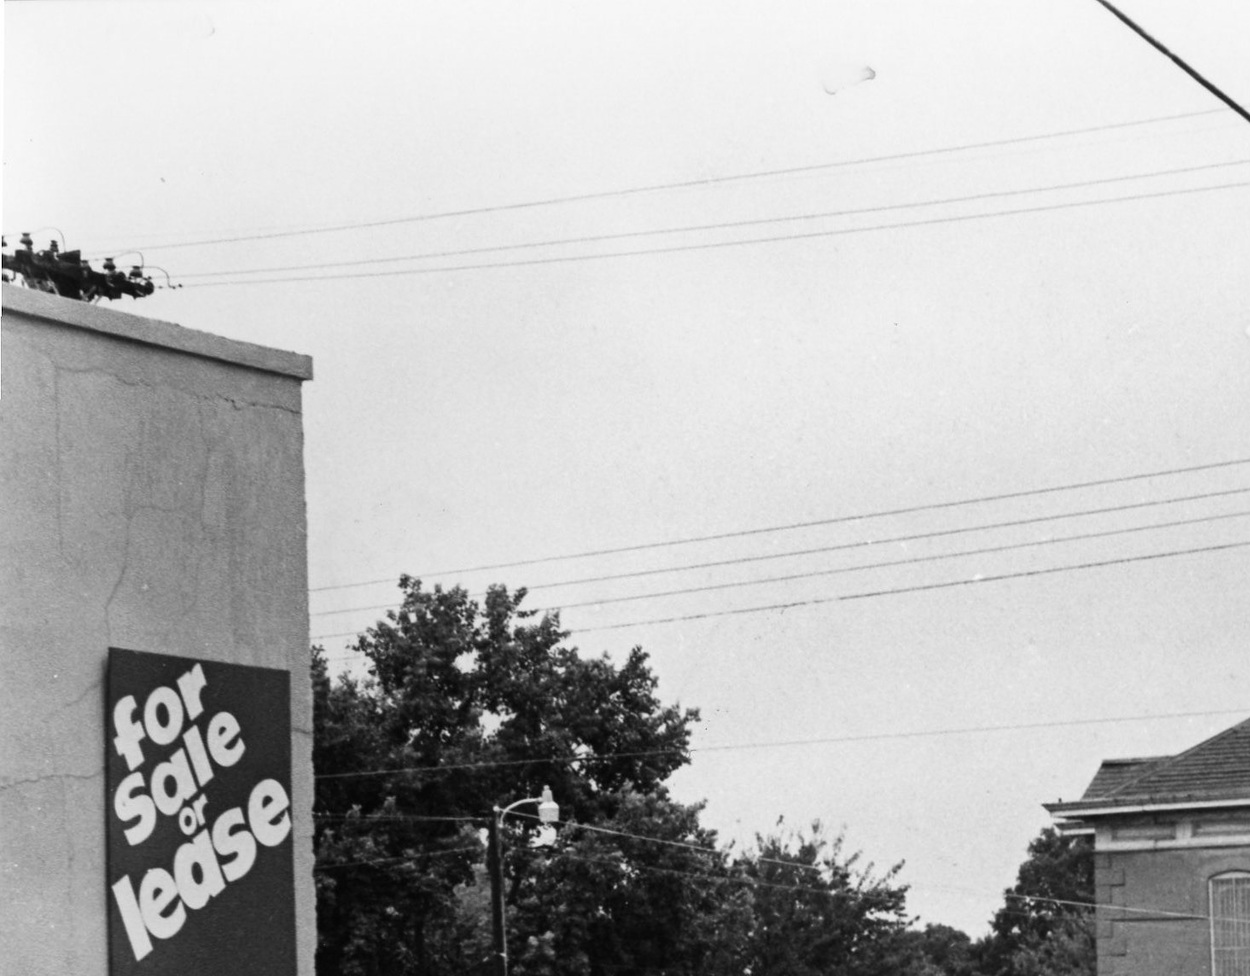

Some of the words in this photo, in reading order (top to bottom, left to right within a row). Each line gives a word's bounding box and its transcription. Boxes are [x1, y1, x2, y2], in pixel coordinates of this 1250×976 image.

[113, 662, 208, 772] for
[114, 711, 246, 846] sale
[178, 793, 208, 836] or
[111, 778, 292, 962] lease
